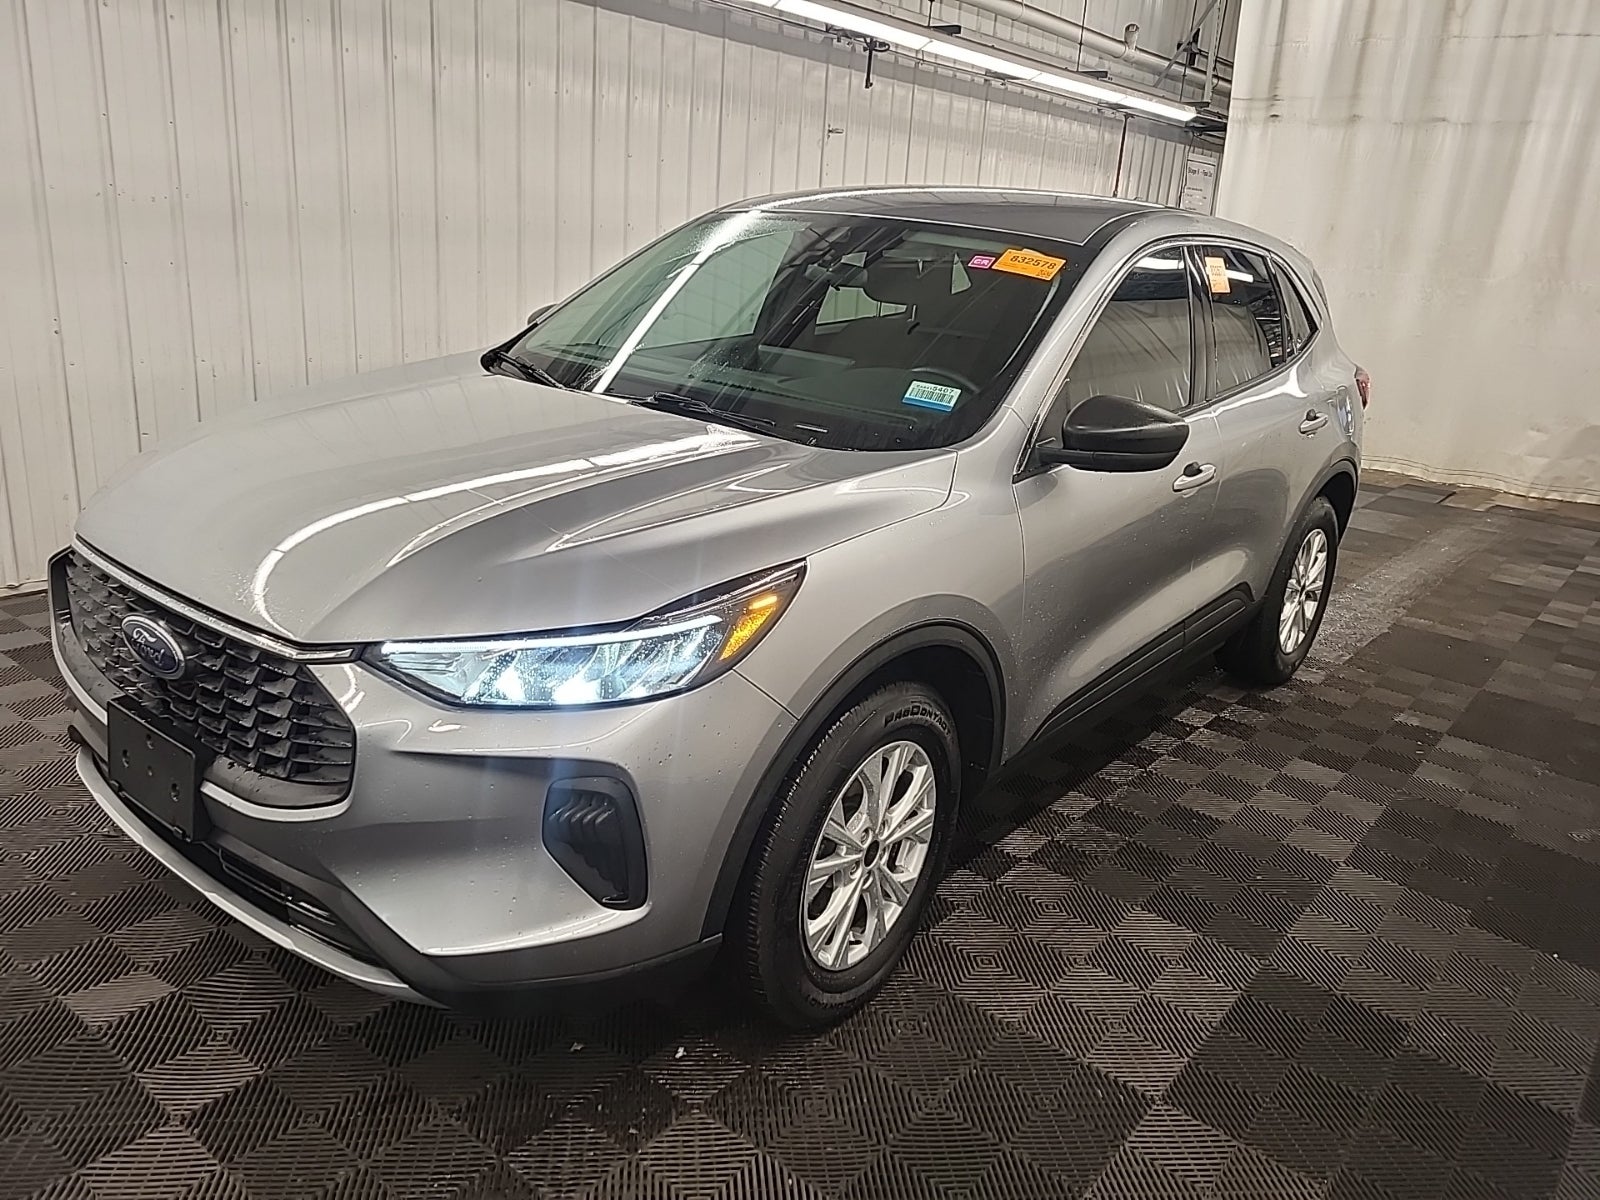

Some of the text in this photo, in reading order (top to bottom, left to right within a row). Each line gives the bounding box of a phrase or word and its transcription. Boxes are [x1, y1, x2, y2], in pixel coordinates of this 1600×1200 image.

[973, 258, 990, 266] CR
[1010, 255, 1057, 270] 832578
[131, 627, 166, 667] Ford
